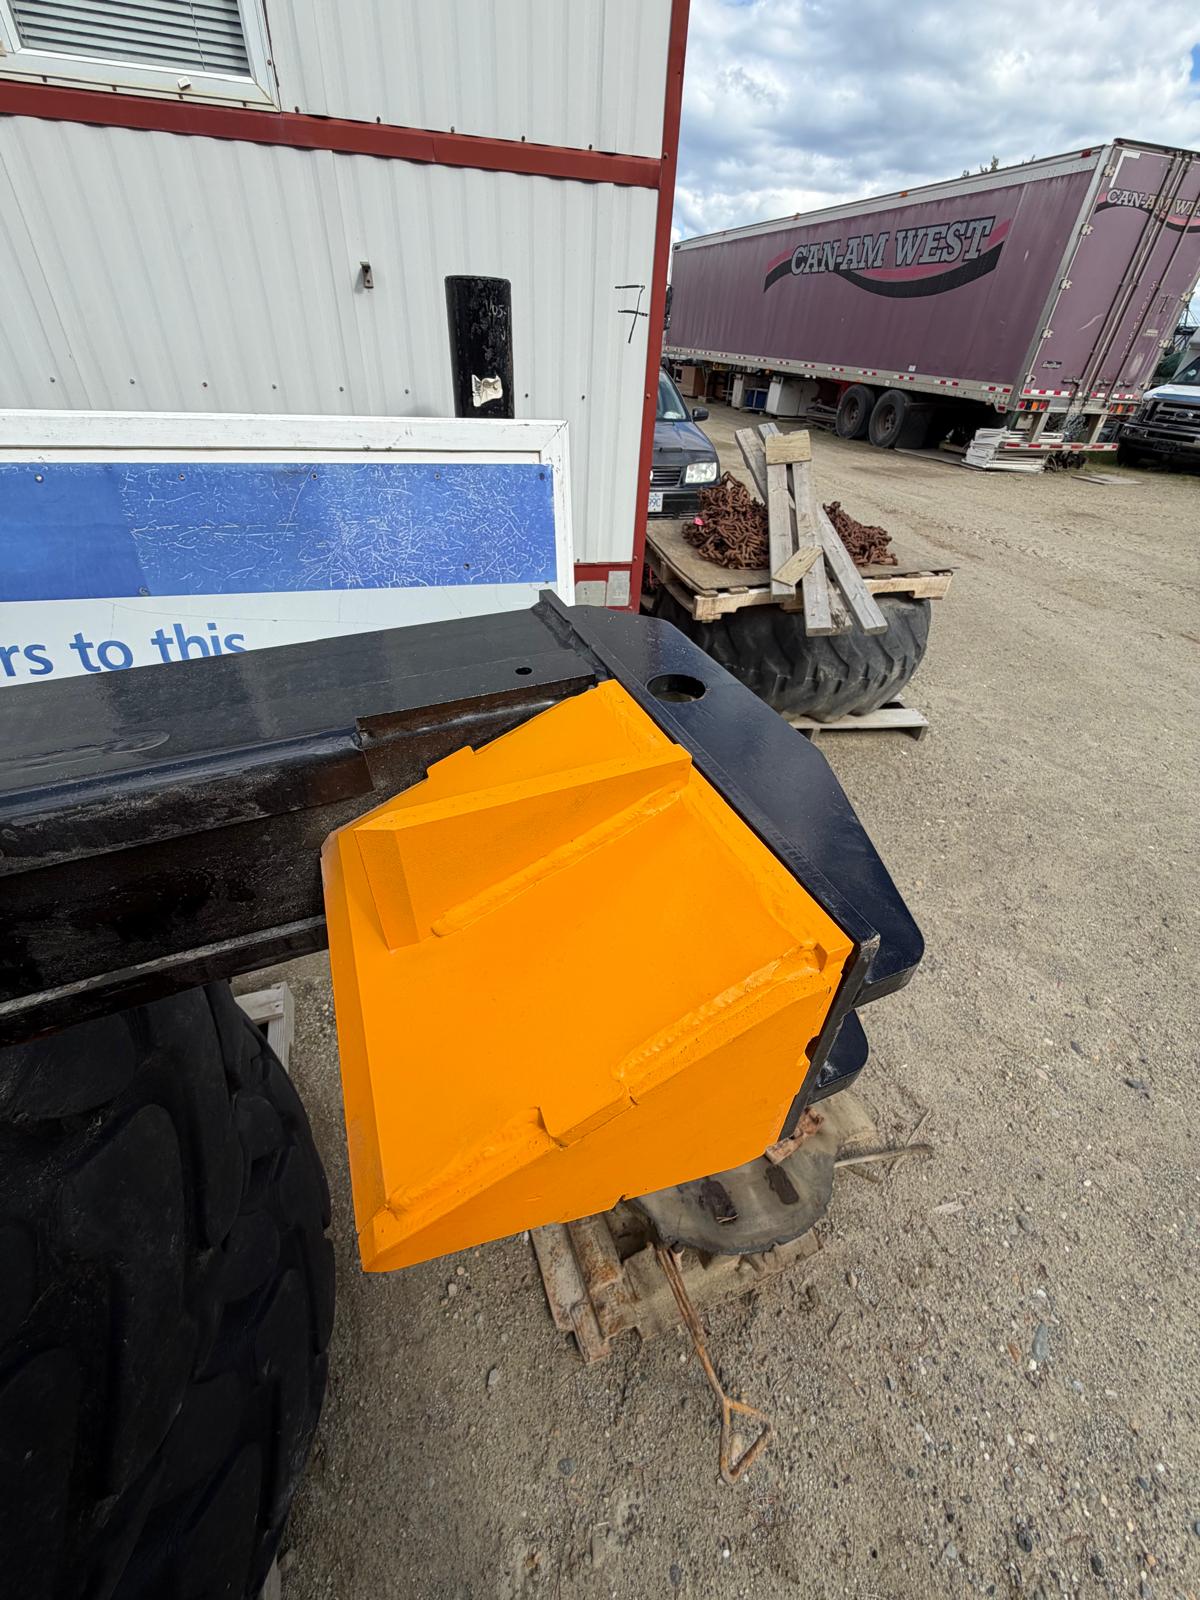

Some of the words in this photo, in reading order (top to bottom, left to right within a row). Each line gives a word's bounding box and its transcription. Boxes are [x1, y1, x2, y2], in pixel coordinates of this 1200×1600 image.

[791, 231, 890, 275] CAN-AM
[895, 216, 996, 266] WEST
[69, 632, 134, 672] to
[150, 622, 249, 663] this
